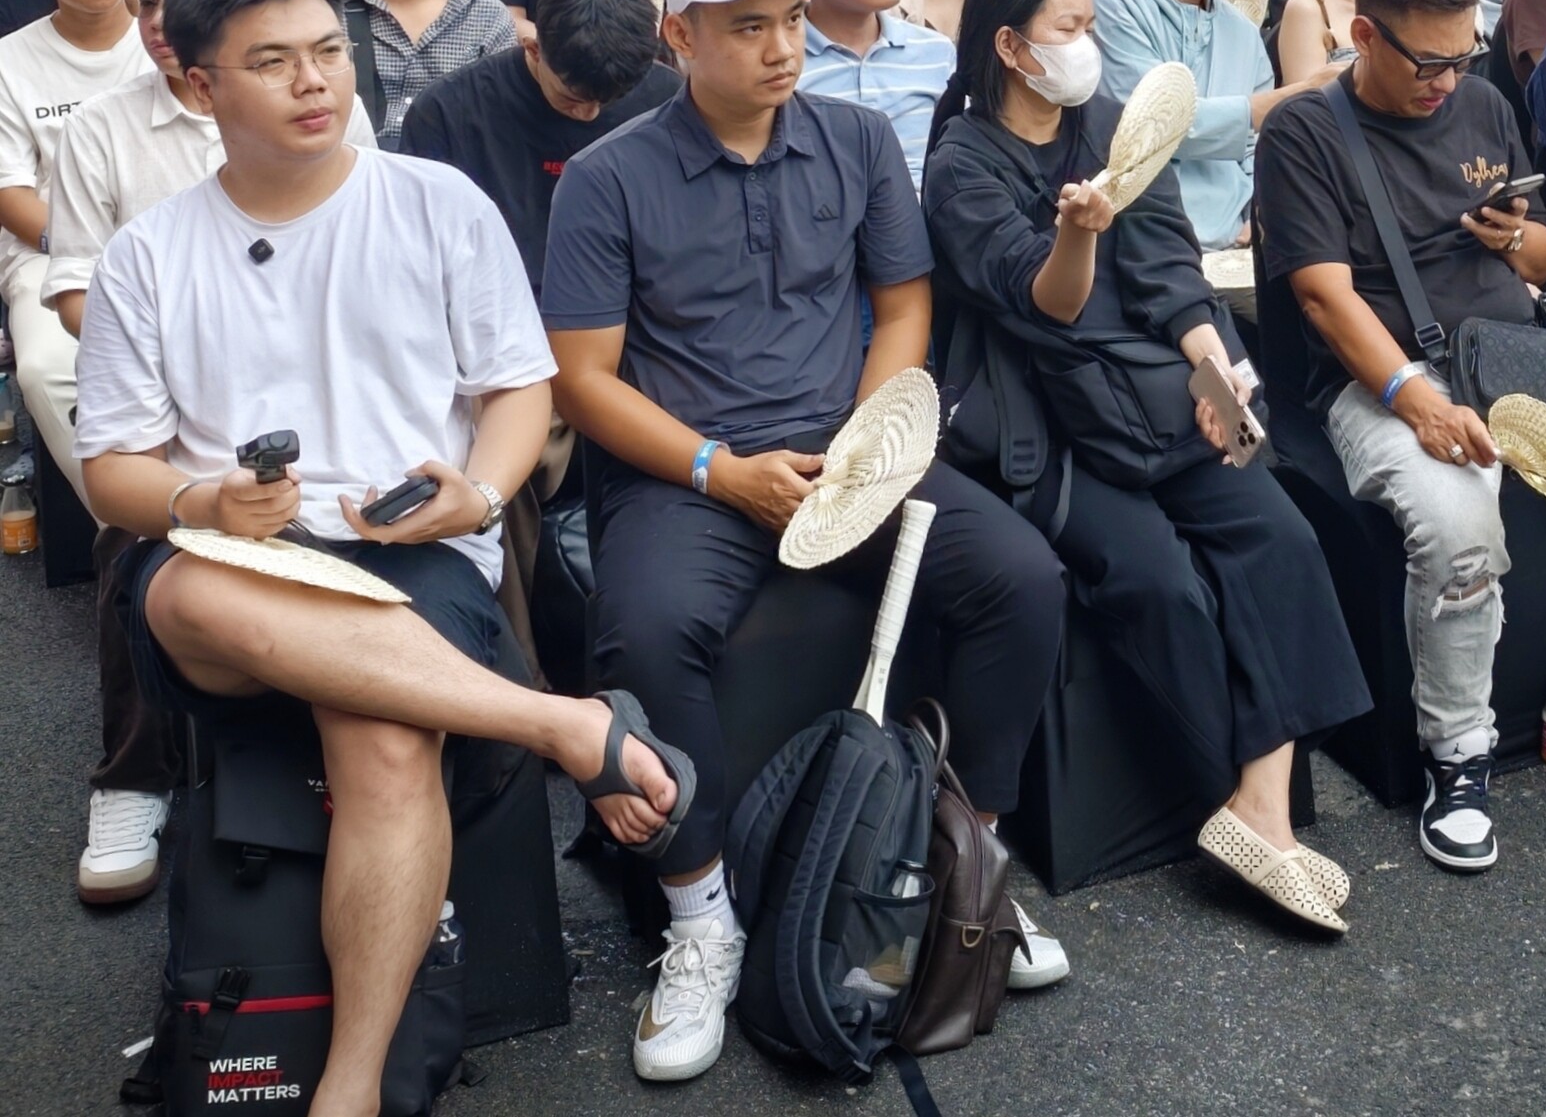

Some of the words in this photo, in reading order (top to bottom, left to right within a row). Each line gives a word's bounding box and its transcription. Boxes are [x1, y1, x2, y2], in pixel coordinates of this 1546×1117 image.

[209, 1055, 277, 1073] WHERE
[208, 1070, 284, 1089] IMPACT
[208, 1084, 301, 1104] MATTERS
